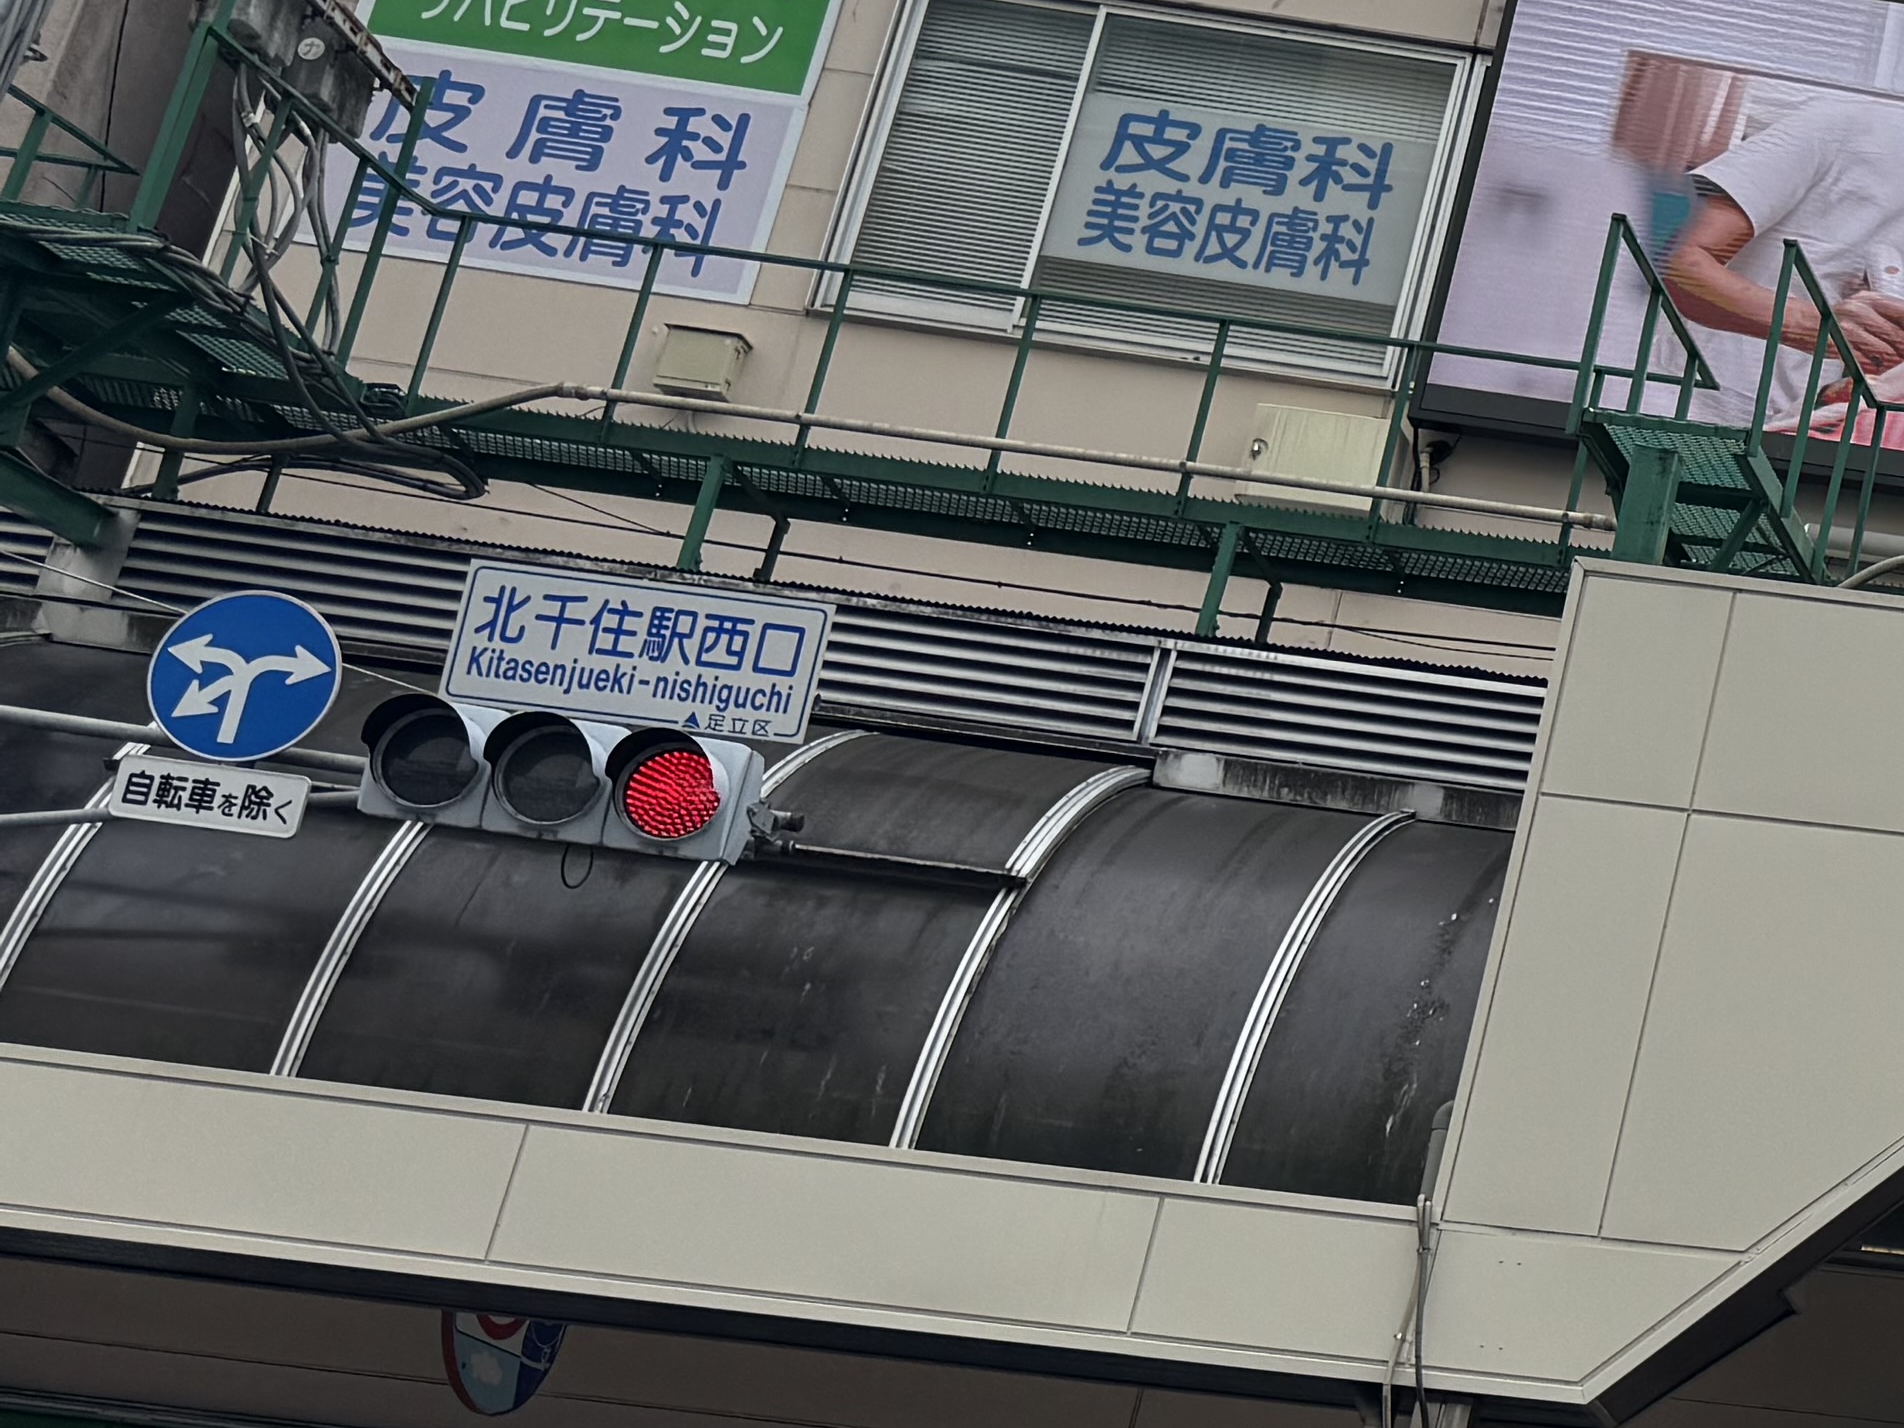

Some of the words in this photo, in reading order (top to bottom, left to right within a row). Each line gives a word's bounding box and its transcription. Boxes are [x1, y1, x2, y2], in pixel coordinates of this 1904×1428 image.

[369, 68, 753, 193] 皮膚科
[1100, 109, 1394, 211] 皮膚科
[347, 150, 722, 279] 美容皮膚科
[1077, 179, 1376, 286] 美容皮膚科
[473, 583, 805, 678] 北千住駅西口
[465, 645, 795, 716] Kitasenjueki-nishiguchi
[704, 713, 772, 737] 足立区
[121, 770, 293, 826] 自転車を除く
